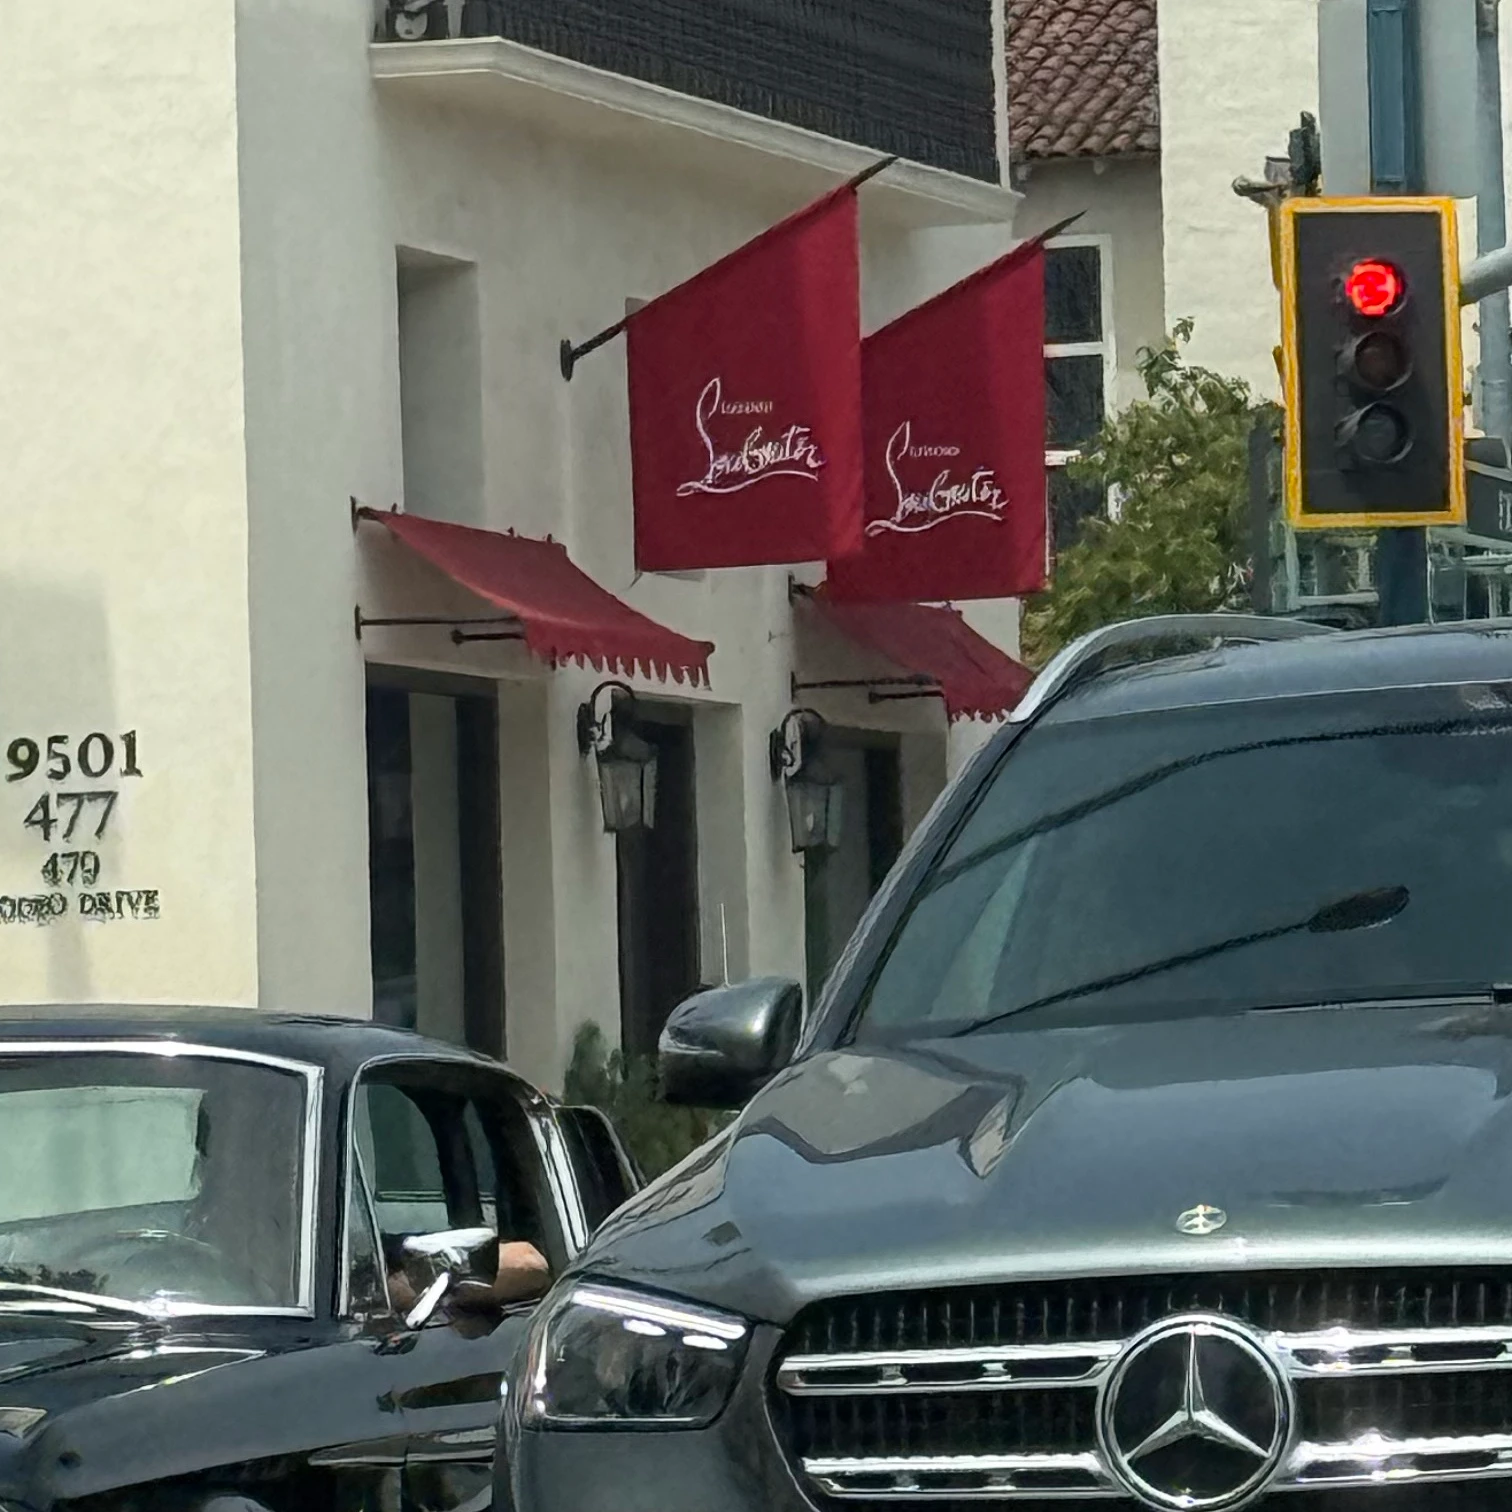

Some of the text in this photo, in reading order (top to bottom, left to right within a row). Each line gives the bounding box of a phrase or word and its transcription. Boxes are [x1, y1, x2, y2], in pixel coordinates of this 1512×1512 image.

[5, 730, 143, 783] 9501
[23, 790, 119, 843] 477
[41, 851, 101, 887] 479
[78, 890, 161, 922] DRIVE
